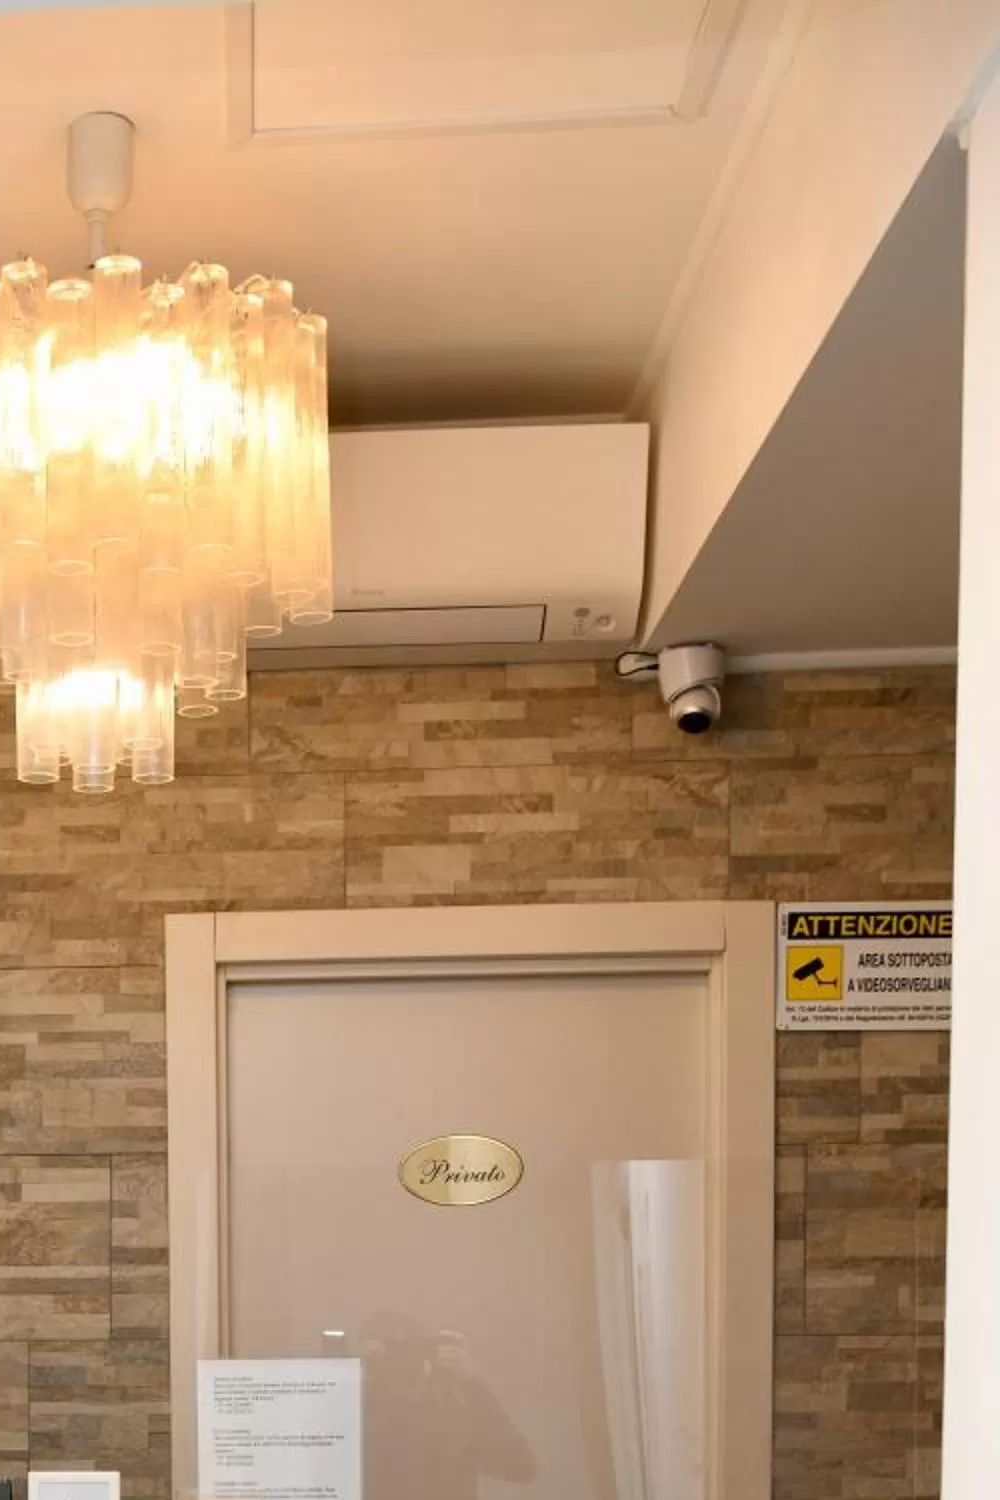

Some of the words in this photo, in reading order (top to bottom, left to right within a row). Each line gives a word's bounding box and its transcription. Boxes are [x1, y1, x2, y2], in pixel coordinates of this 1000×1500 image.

[792, 914, 952, 937] ATTENZIONE
[857, 953, 885, 968] AREA
[847, 979, 855, 992] A
[419, 1159, 506, 1184] Privato
